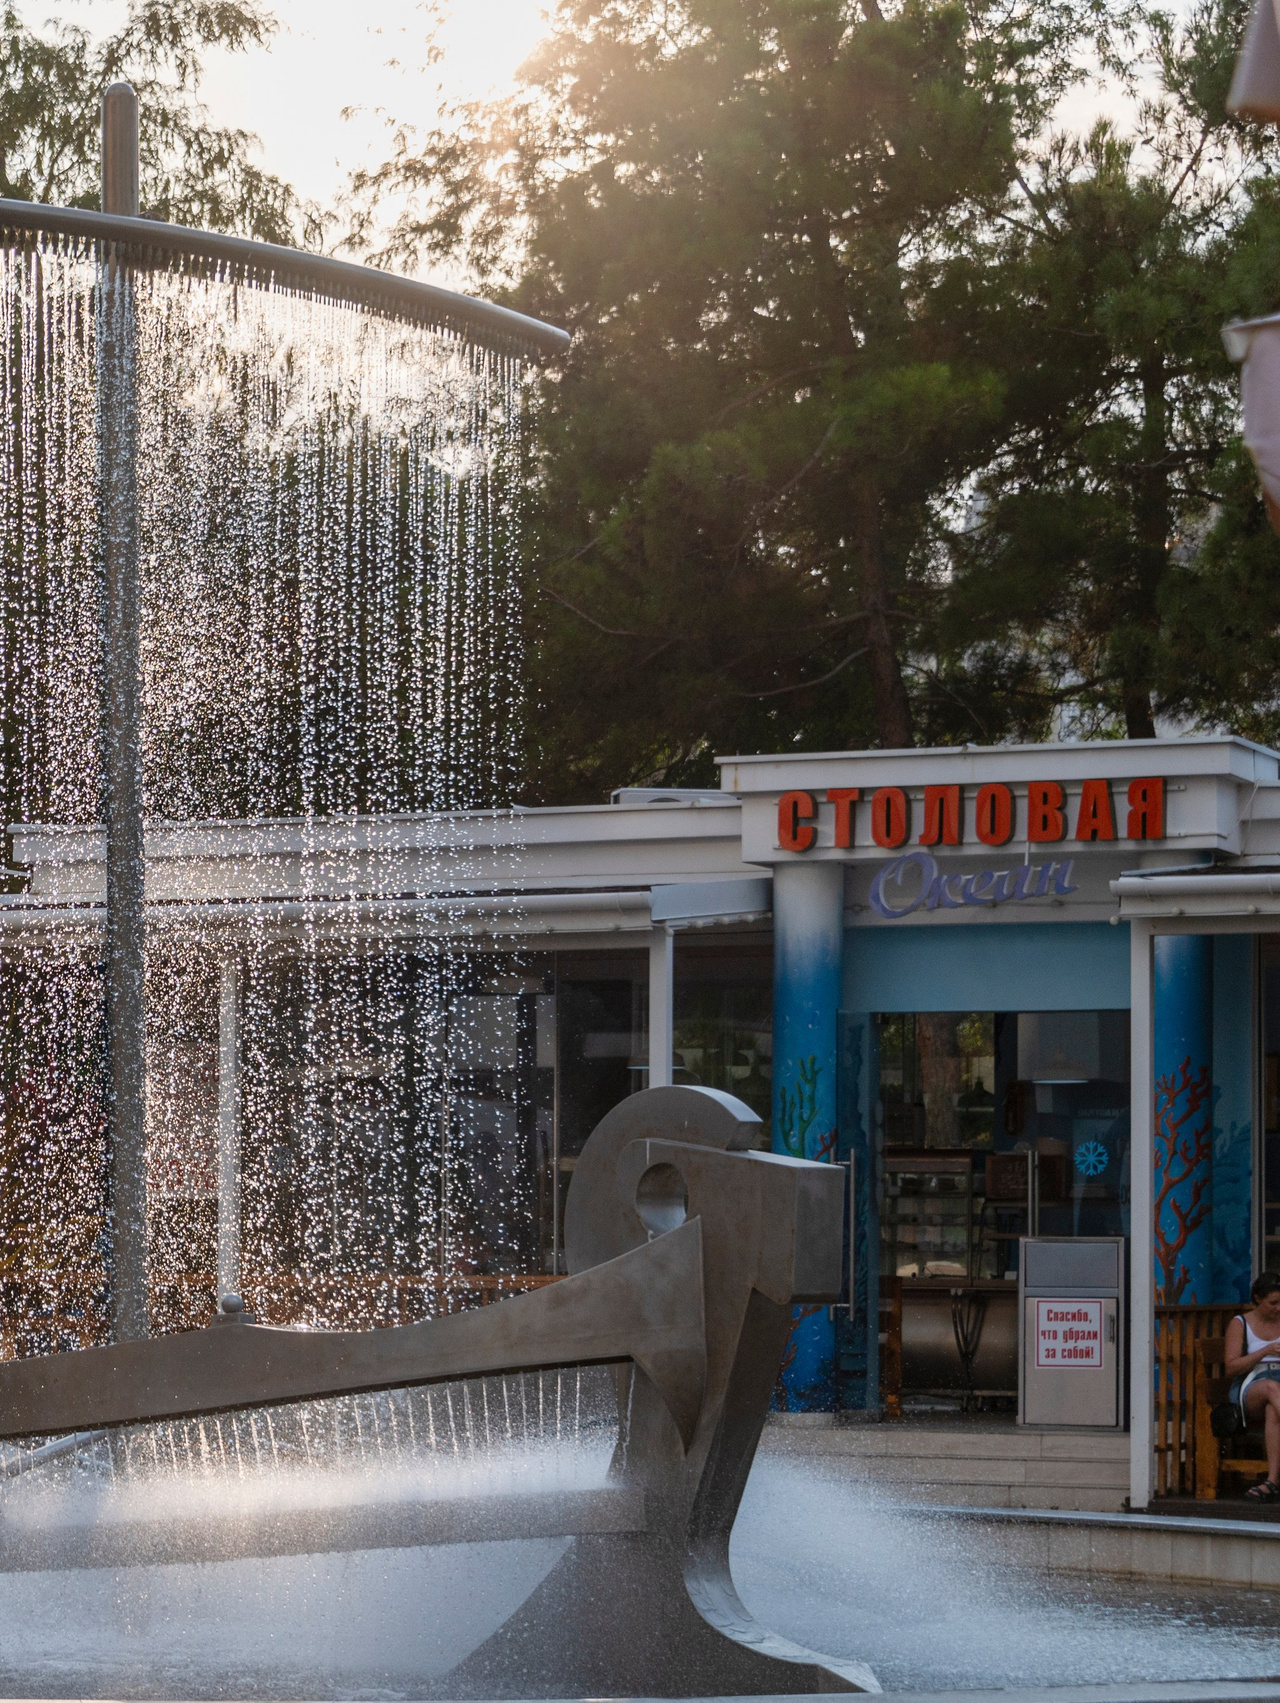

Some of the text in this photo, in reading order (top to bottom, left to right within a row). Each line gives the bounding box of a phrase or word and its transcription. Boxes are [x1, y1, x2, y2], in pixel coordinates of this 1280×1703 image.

[777, 777, 1167, 853] СТОЛОВАЯ
[868, 852, 1080, 919] Океан
[1046, 1309, 1093, 1324] Спасибо,
[1040, 1328, 1099, 1343] что убрали
[1044, 1346, 1095, 1359] за собой!
